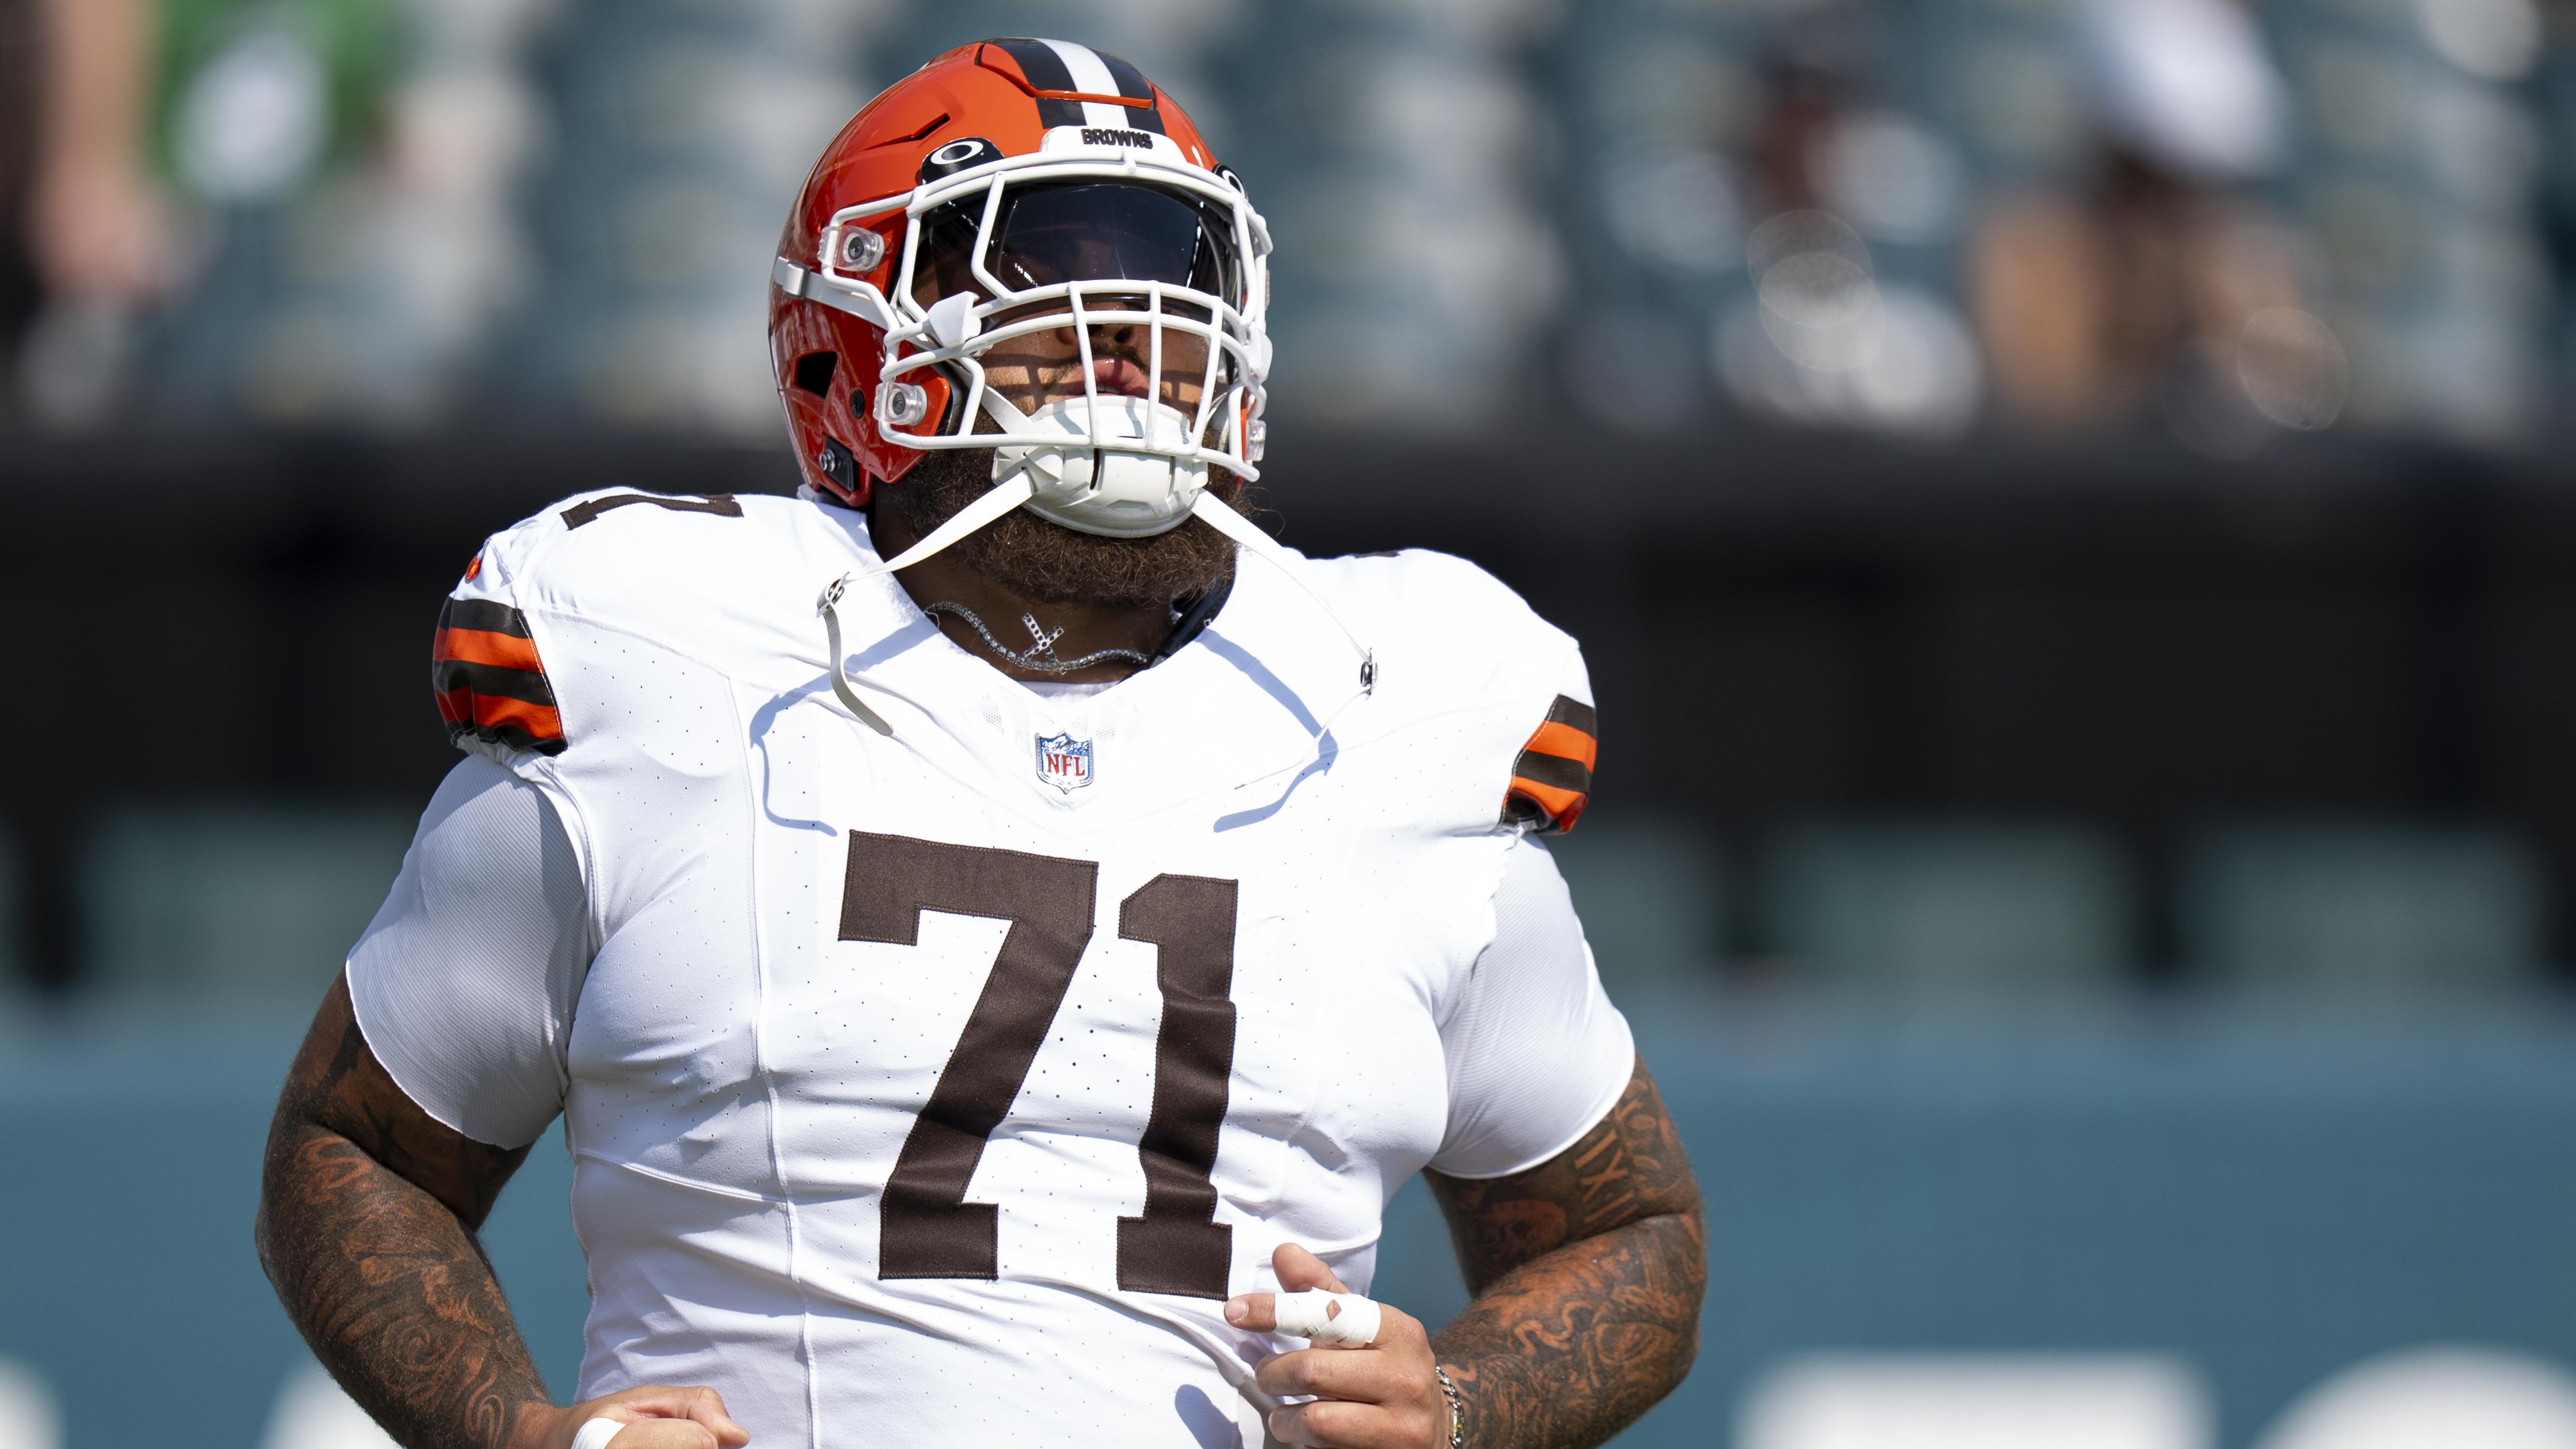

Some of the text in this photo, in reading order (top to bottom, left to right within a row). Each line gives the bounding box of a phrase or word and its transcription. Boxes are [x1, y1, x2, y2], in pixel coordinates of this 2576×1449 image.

[1081, 129, 1153, 149] BROWNS
[1046, 753, 1085, 776] NFL
[837, 829, 1238, 1301] 71
